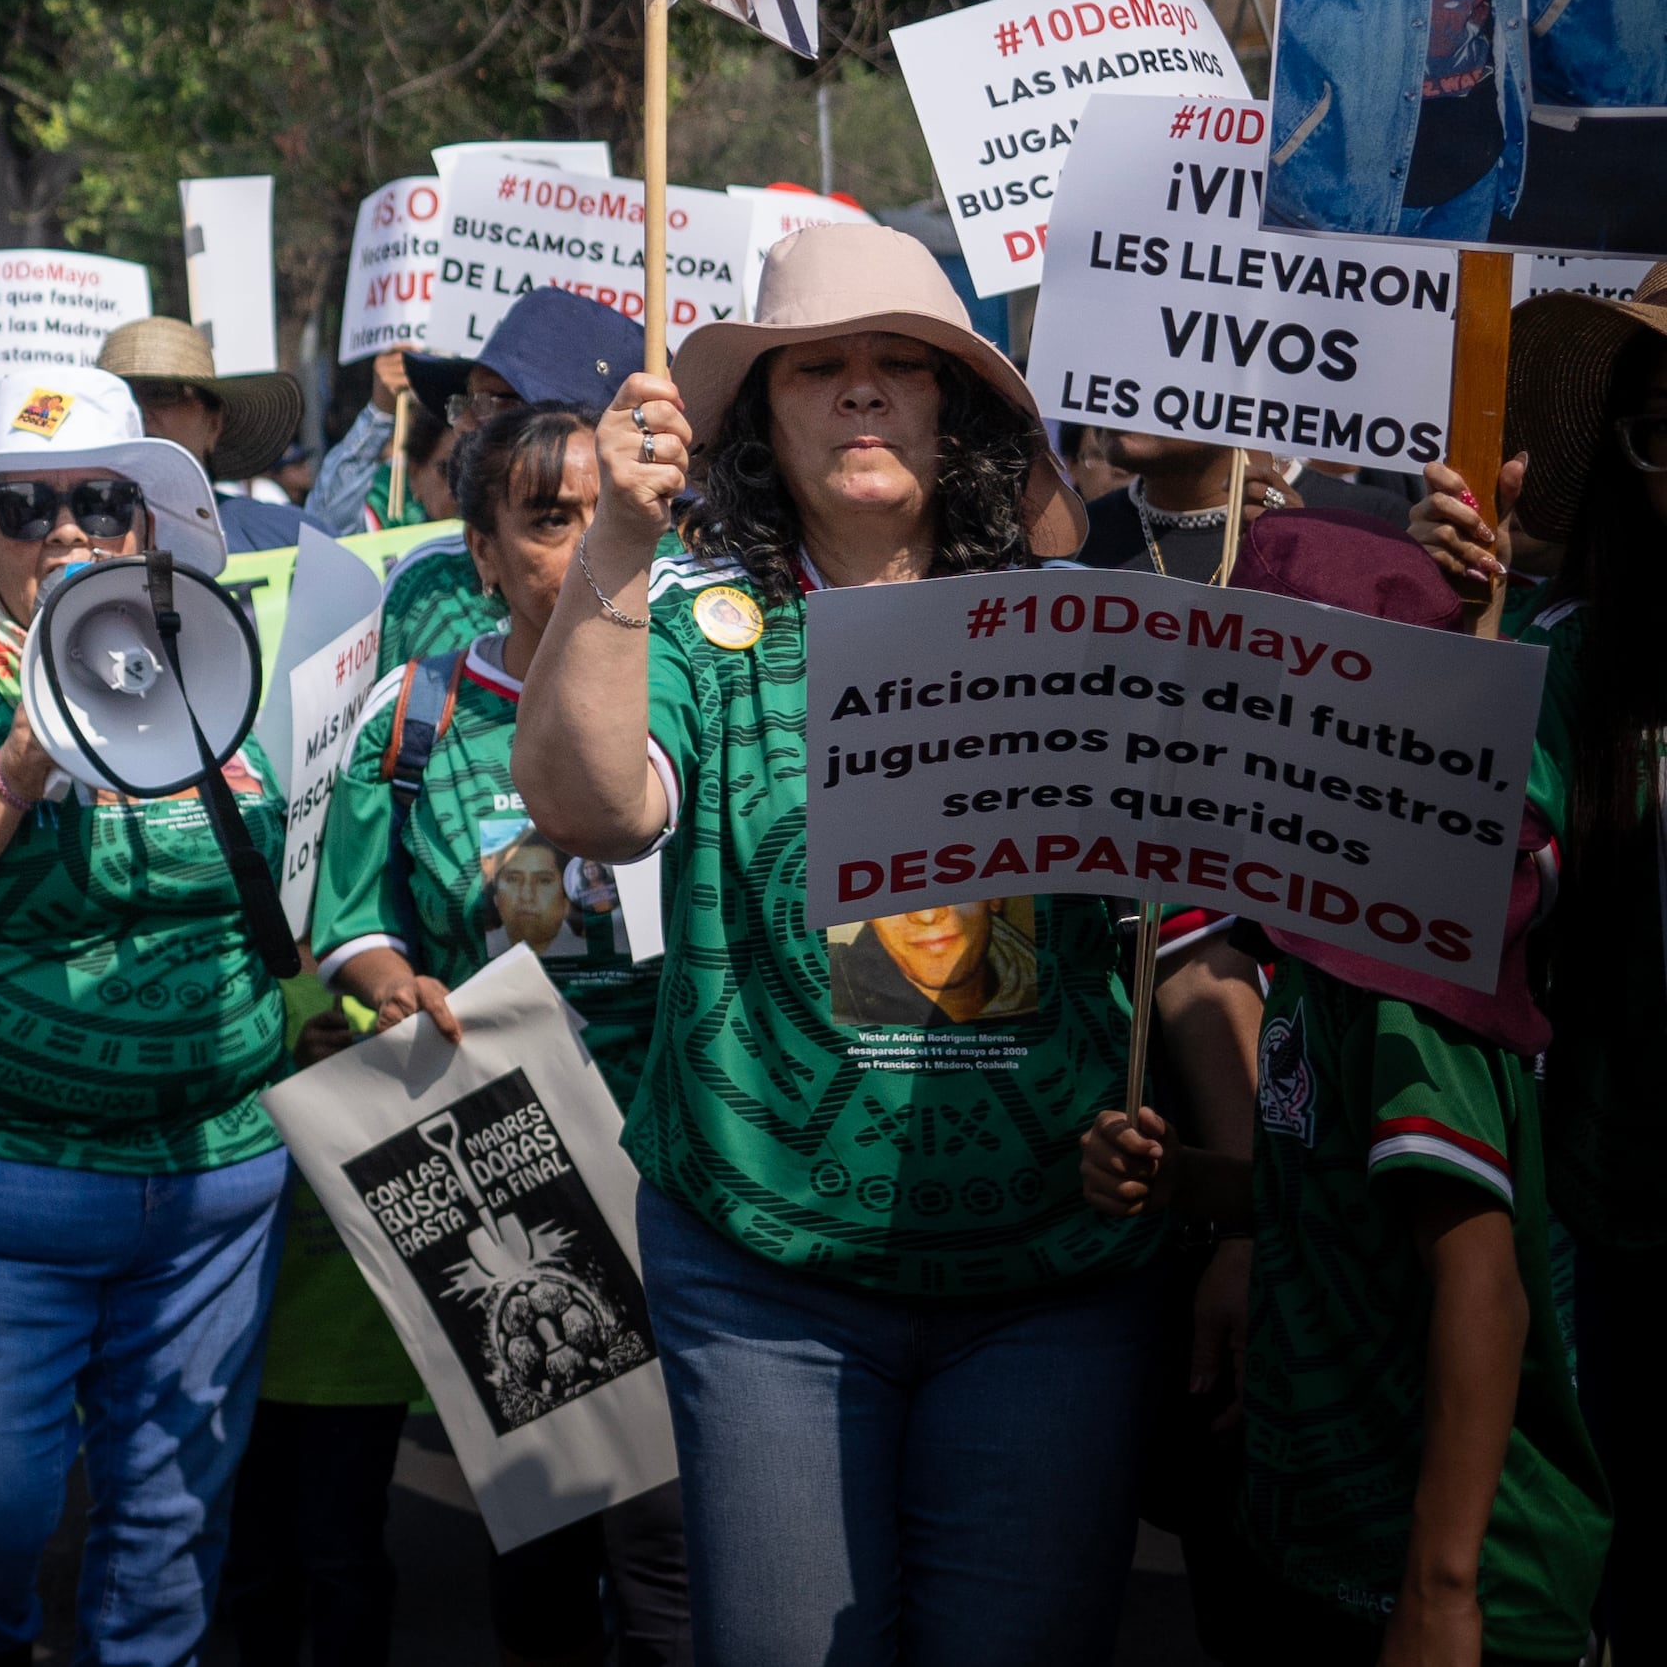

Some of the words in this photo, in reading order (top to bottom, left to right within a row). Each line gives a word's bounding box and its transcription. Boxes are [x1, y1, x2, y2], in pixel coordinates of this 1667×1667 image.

[985, 70, 1056, 108] LAS
[1062, 48, 1189, 89] MADRES
[1192, 50, 1224, 78] NOS
[441, 257, 484, 290] DE
[453, 215, 604, 264] BUSCAMOS
[1090, 230, 1170, 277] LES
[6, 290, 43, 308] que
[1160, 305, 1360, 383] VIVOS
[1060, 370, 1141, 419] LES
[1153, 385, 1444, 466] QUEREMOS
[967, 593, 1374, 684] #10DeMayo
[830, 664, 1186, 722] Aficionados
[1202, 681, 1294, 727] del
[1310, 703, 1510, 792] futbol,
[824, 726, 1109, 788] juguemos
[1125, 729, 1228, 767] por
[1245, 749, 1507, 847] nuestros
[942, 784, 1094, 818] seres
[1110, 787, 1373, 866] queridos
[837, 836, 1474, 964] DESAPARECIDOS
[847, 1047, 916, 1057] desaparecido
[918, 1047, 927, 1056] el
[931, 1047, 942, 1056] 11
[945, 1047, 958, 1056] de
[960, 1049, 986, 1058] mayo
[988, 1047, 1001, 1056] de
[857, 1061, 871, 1069] en
[873, 1060, 922, 1070] Francisco
[934, 1061, 974, 1071] Madero,
[975, 1060, 1019, 1070] Coahuila
[978, 1033, 1015, 1043] Moreno
[364, 1176, 410, 1213] CON
[406, 1155, 448, 1190] LAS
[464, 1101, 545, 1158] MADRES
[394, 1206, 467, 1258] HASTA
[486, 1187, 510, 1209] LA
[507, 1151, 571, 1197] FINAL
